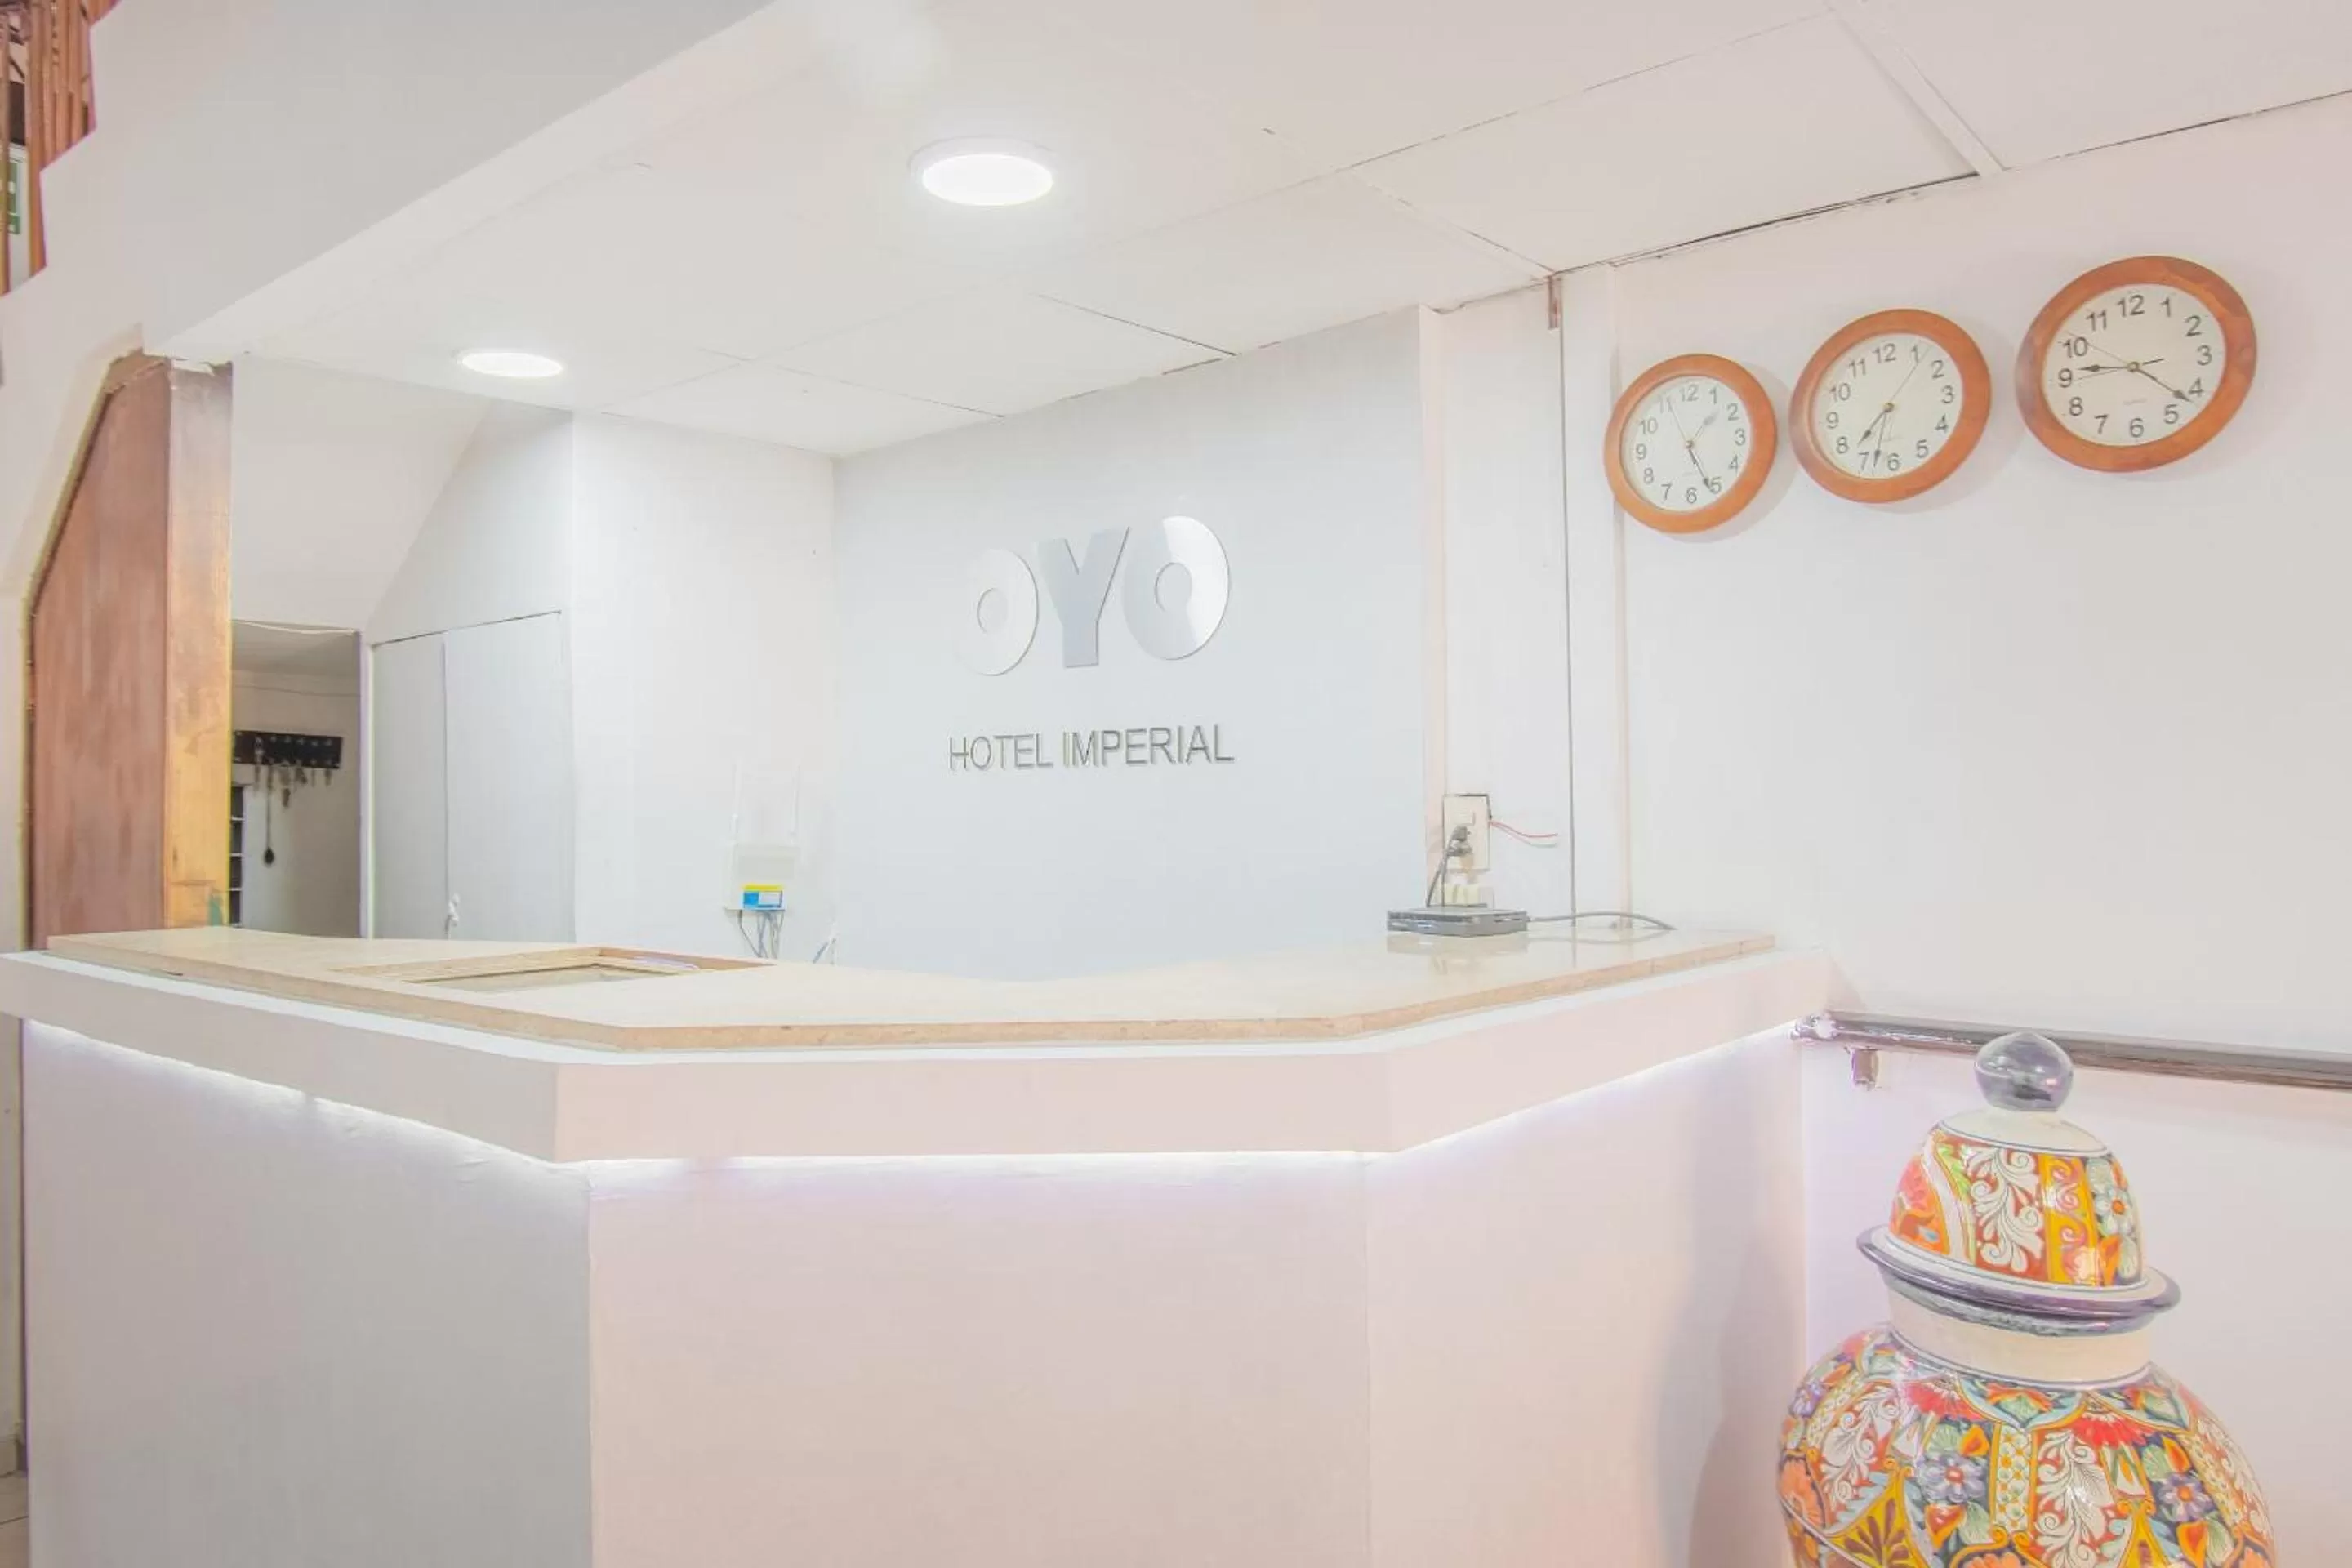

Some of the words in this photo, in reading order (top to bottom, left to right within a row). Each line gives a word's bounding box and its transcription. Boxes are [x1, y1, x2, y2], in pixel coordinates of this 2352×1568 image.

[2117, 294, 2145, 318] 12
[2162, 297, 2172, 318] 1
[2086, 310, 2108, 331] 11
[2185, 314, 2203, 337] 2
[1872, 343, 1897, 364] 12
[1911, 344, 1920, 363] 1
[2062, 336, 2088, 359] 10
[2197, 345, 2212, 366] 3
[1849, 358, 1867, 379] 11
[1931, 360, 1944, 379] 2
[2058, 368, 2073, 388] 9
[1680, 384, 1699, 402] 12
[1709, 387, 1717, 404] 1
[1829, 382, 1851, 402] 10
[1941, 385, 1954, 404] 3
[2188, 377, 2204, 398] 4
[1659, 394, 1673, 413] 11
[1727, 403, 1740, 421] 2
[2069, 396, 2083, 416] 8
[1826, 412, 1839, 430] 9
[1935, 414, 1949, 434] 4
[2094, 414, 2109, 434] 7
[2163, 403, 2179, 425] 5
[1640, 417, 1659, 434] 10
[2129, 417, 2145, 438] 6
[1735, 428, 1746, 446] 3
[1837, 436, 1850, 454] 8
[1636, 443, 1647, 460] 9
[1916, 439, 1929, 458] 5
[1728, 454, 1740, 475] 4
[1858, 451, 1869, 471] 7
[1887, 452, 1900, 472] 6
[1643, 467, 1654, 484] 8
[1709, 476, 1722, 494] 5
[1661, 483, 1673, 501] 7
[1686, 487, 1697, 504] 6
[952, 514, 1231, 677] OYO
[948, 732, 1054, 771] HOTEL
[1062, 723, 1235, 767] IMPERIAL
